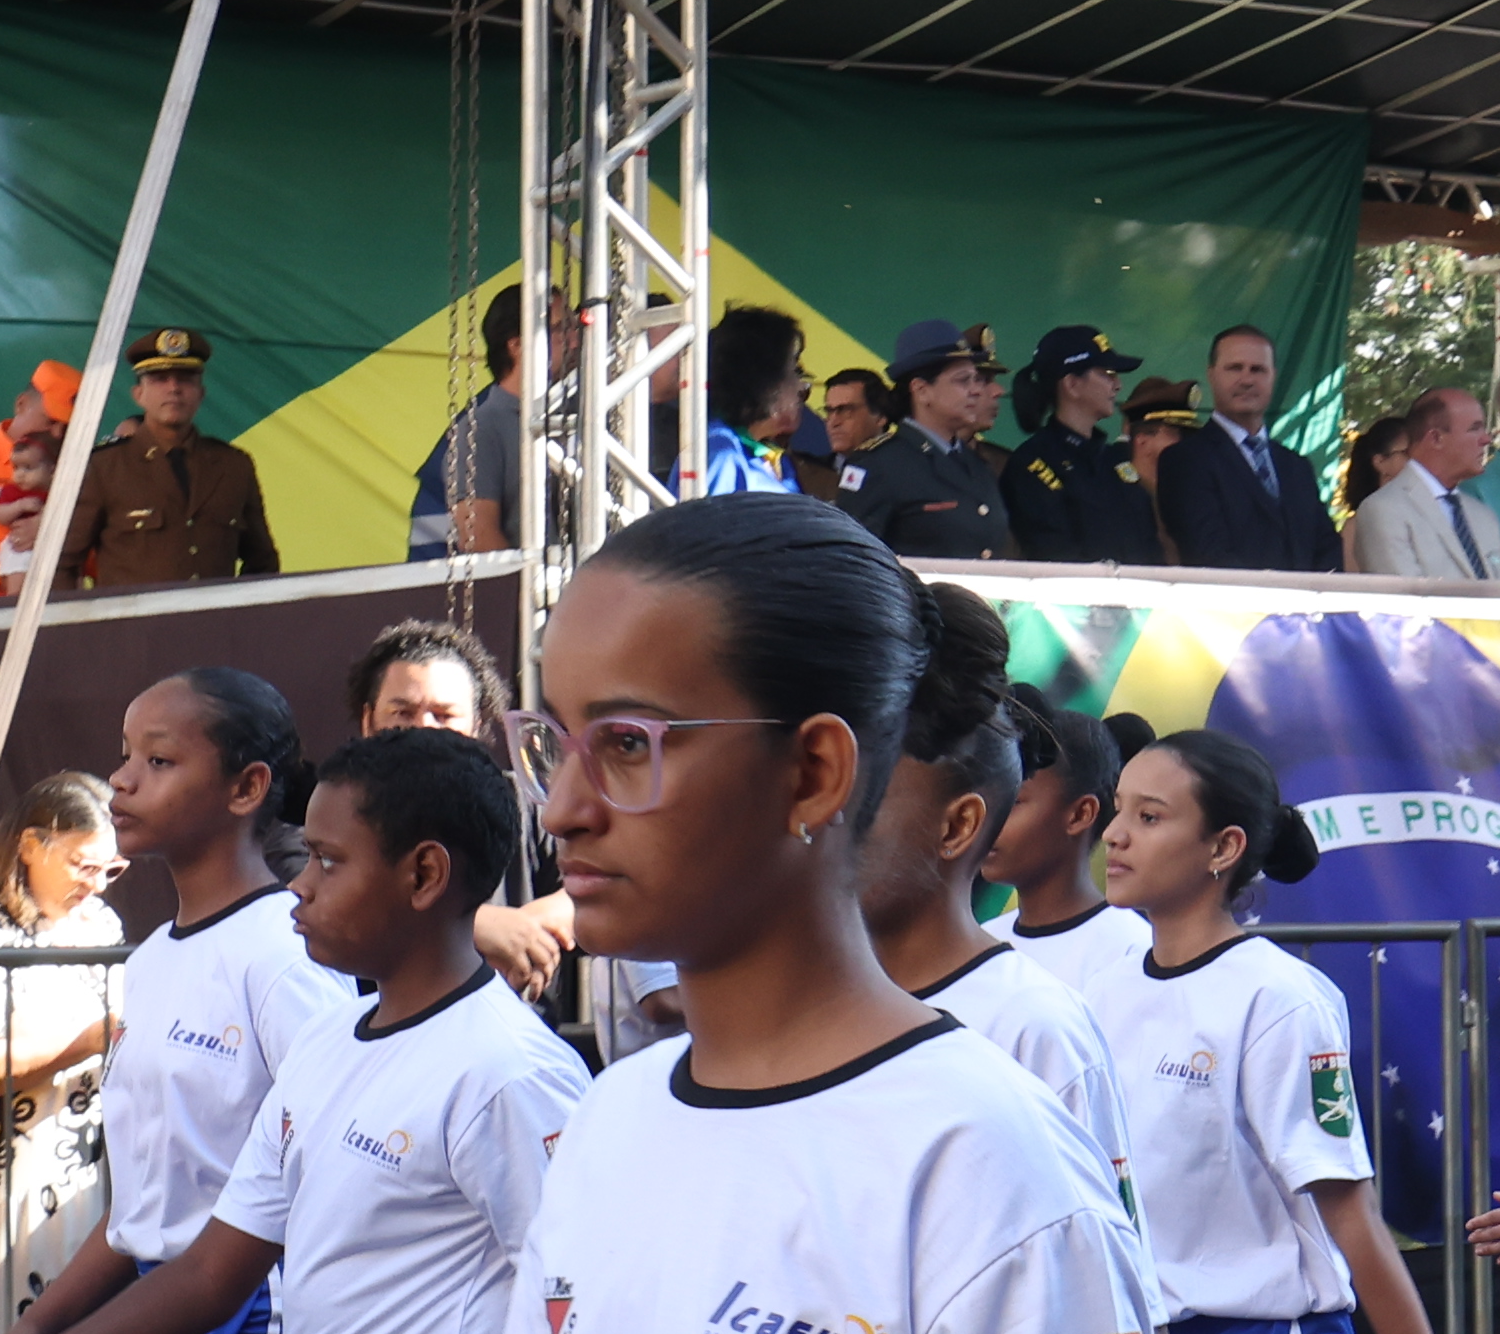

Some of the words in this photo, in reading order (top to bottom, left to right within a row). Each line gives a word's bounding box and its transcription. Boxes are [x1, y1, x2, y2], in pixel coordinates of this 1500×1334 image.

[1358, 804, 1382, 835] E
[167, 1019, 220, 1049] Icasu
[1155, 1053, 1190, 1076] Icasu
[342, 1119, 384, 1156] Icasu
